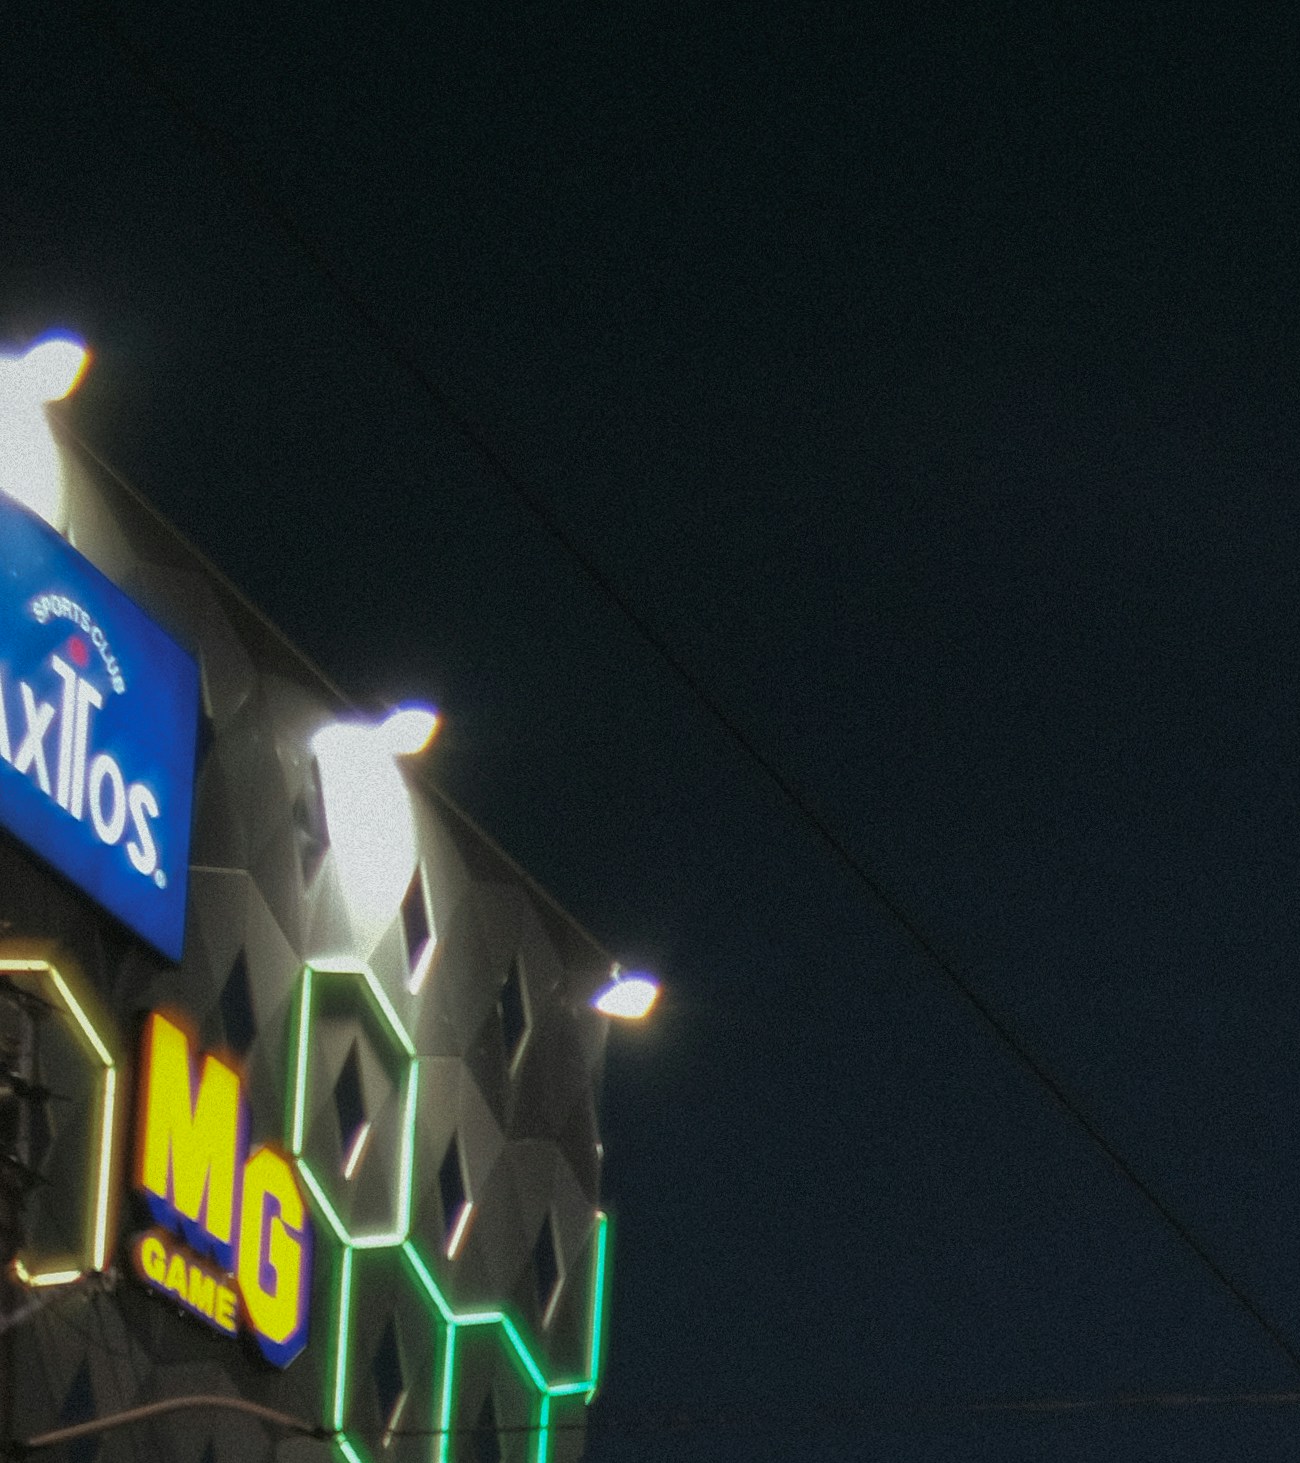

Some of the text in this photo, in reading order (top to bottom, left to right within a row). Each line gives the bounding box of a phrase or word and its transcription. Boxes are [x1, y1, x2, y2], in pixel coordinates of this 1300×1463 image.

[32, 593, 125, 695] SPORTS CLUB
[142, 1012, 304, 1344] MG
[141, 1236, 239, 1334] GAME
